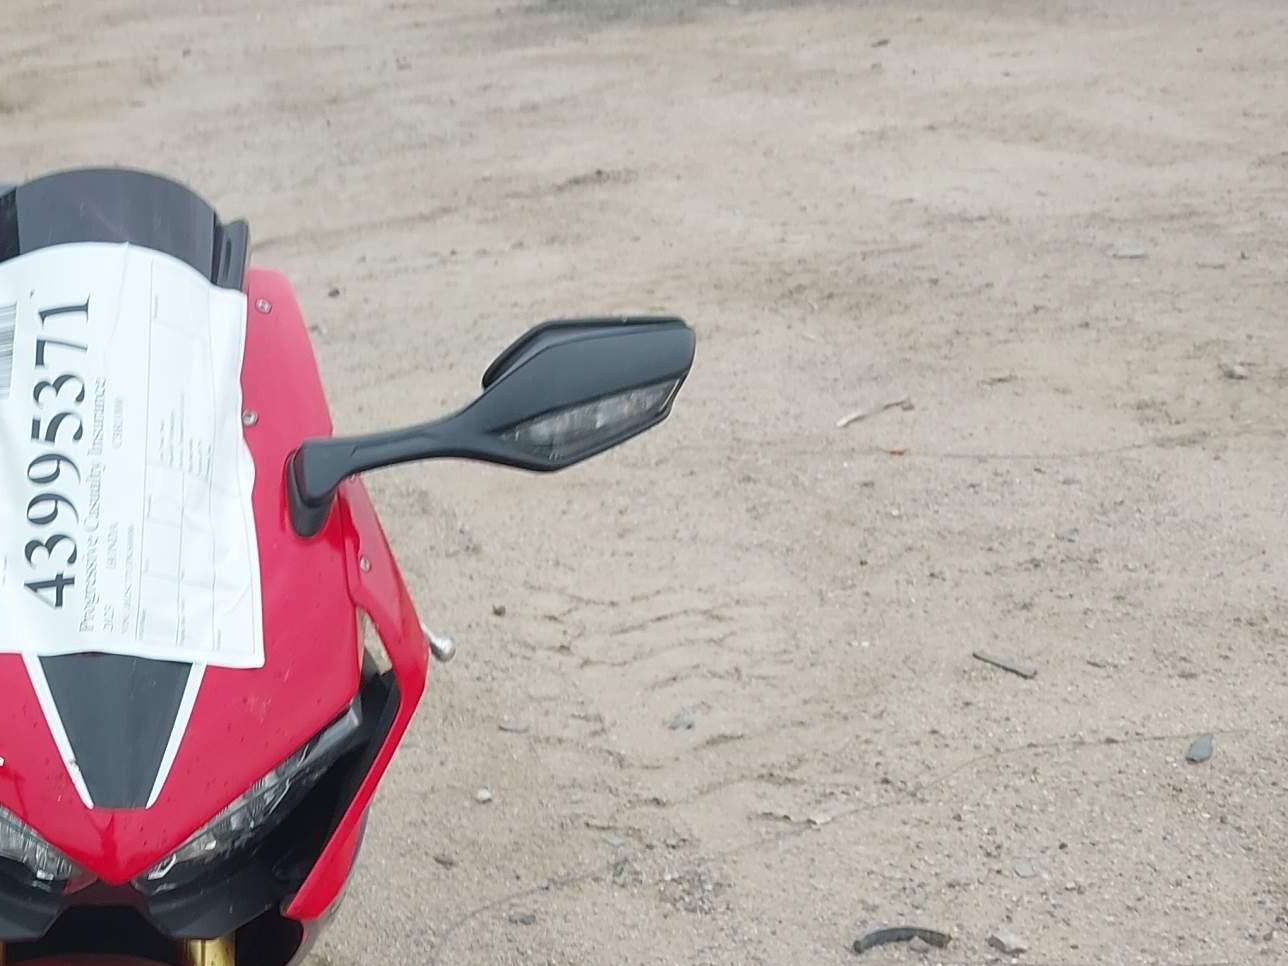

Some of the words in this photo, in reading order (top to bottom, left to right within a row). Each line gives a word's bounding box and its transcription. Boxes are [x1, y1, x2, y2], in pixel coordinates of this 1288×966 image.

[24, 293, 91, 608] 43995371
[88, 376, 107, 456] Insurance
[79, 535, 100, 633] Progressive
